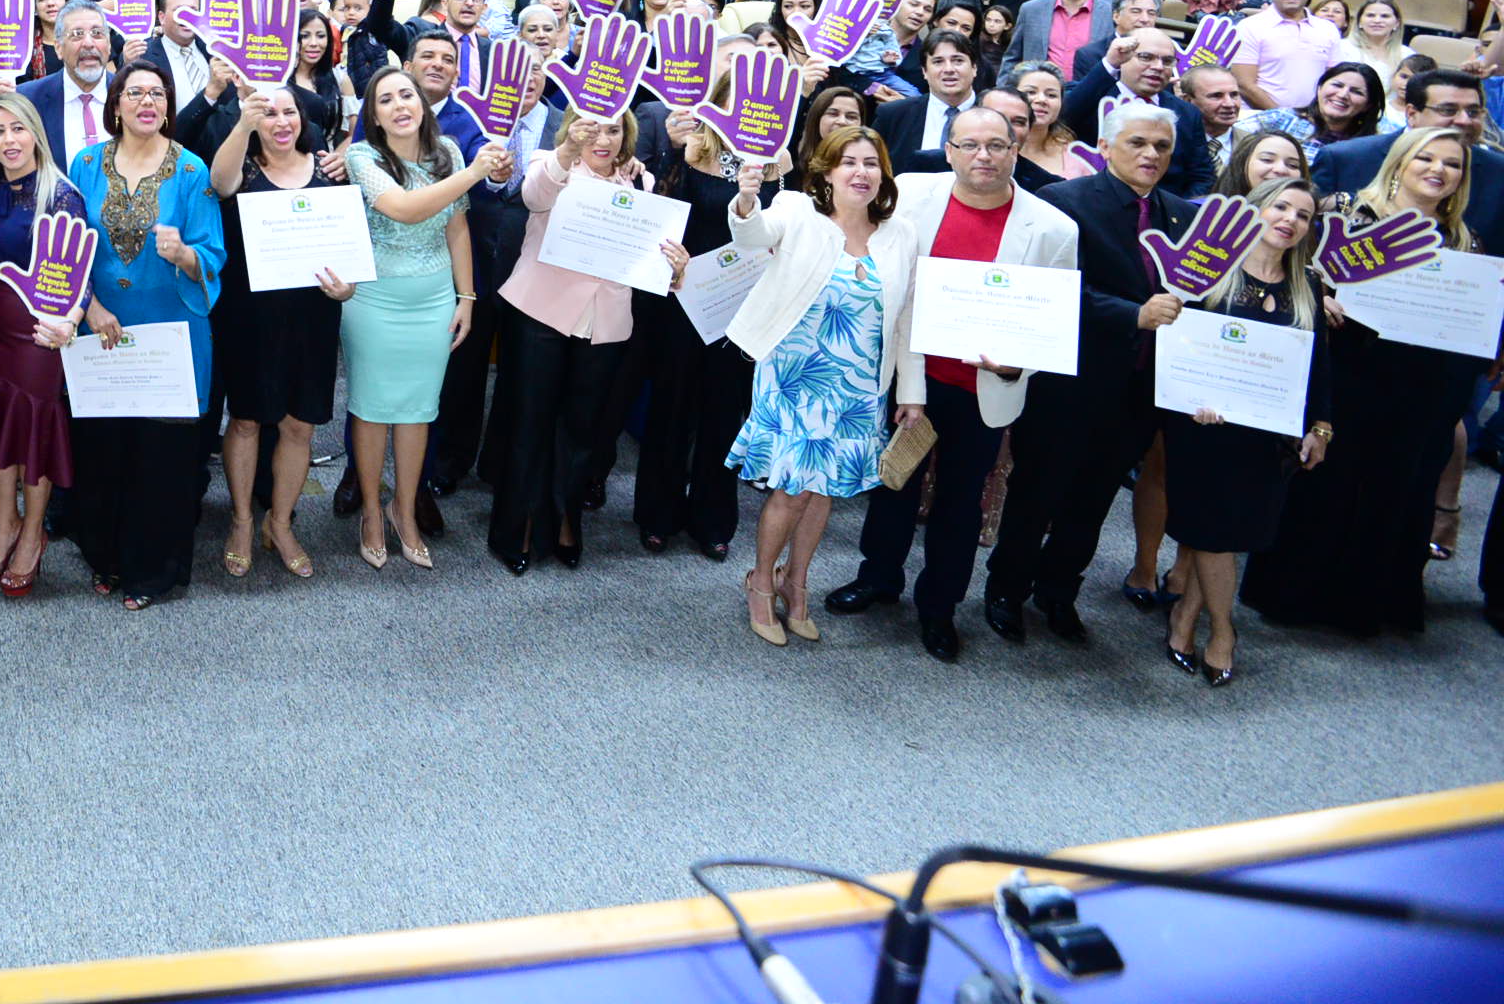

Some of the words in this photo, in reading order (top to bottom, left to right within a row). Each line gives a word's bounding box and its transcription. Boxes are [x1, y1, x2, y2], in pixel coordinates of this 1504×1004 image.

[209, 9, 229, 18] base
[209, 18, 233, 28] tudo!
[246, 44, 261, 52] não
[591, 60, 598, 68] O
[598, 64, 621, 75] amor
[664, 59, 671, 67] O
[671, 58, 699, 68] melhor
[587, 68, 598, 77] da
[598, 71, 625, 84] pátria
[675, 74, 704, 83] Família
[582, 84, 612, 97] Família
[585, 76, 615, 90] começa
[614, 86, 627, 94] na
[742, 99, 750, 107] O
[750, 101, 775, 112] amor
[740, 107, 753, 116] da
[752, 109, 781, 121] pátria
[738, 123, 769, 136] Família
[739, 117, 771, 130] começa
[771, 122, 784, 130] na
[1186, 249, 1211, 264] meu
[1193, 239, 1229, 260] Família
[1350, 240, 1368, 260] base
[1361, 258, 1375, 271] de
[1361, 236, 1385, 266] Família
[39, 266, 68, 280] Família
[40, 259, 48, 267] A
[47, 262, 73, 273] minha
[1180, 258, 1222, 279] alicerce!
[37, 273, 44, 282] é
[35, 282, 46, 291] do
[46, 284, 74, 297] Senhor
